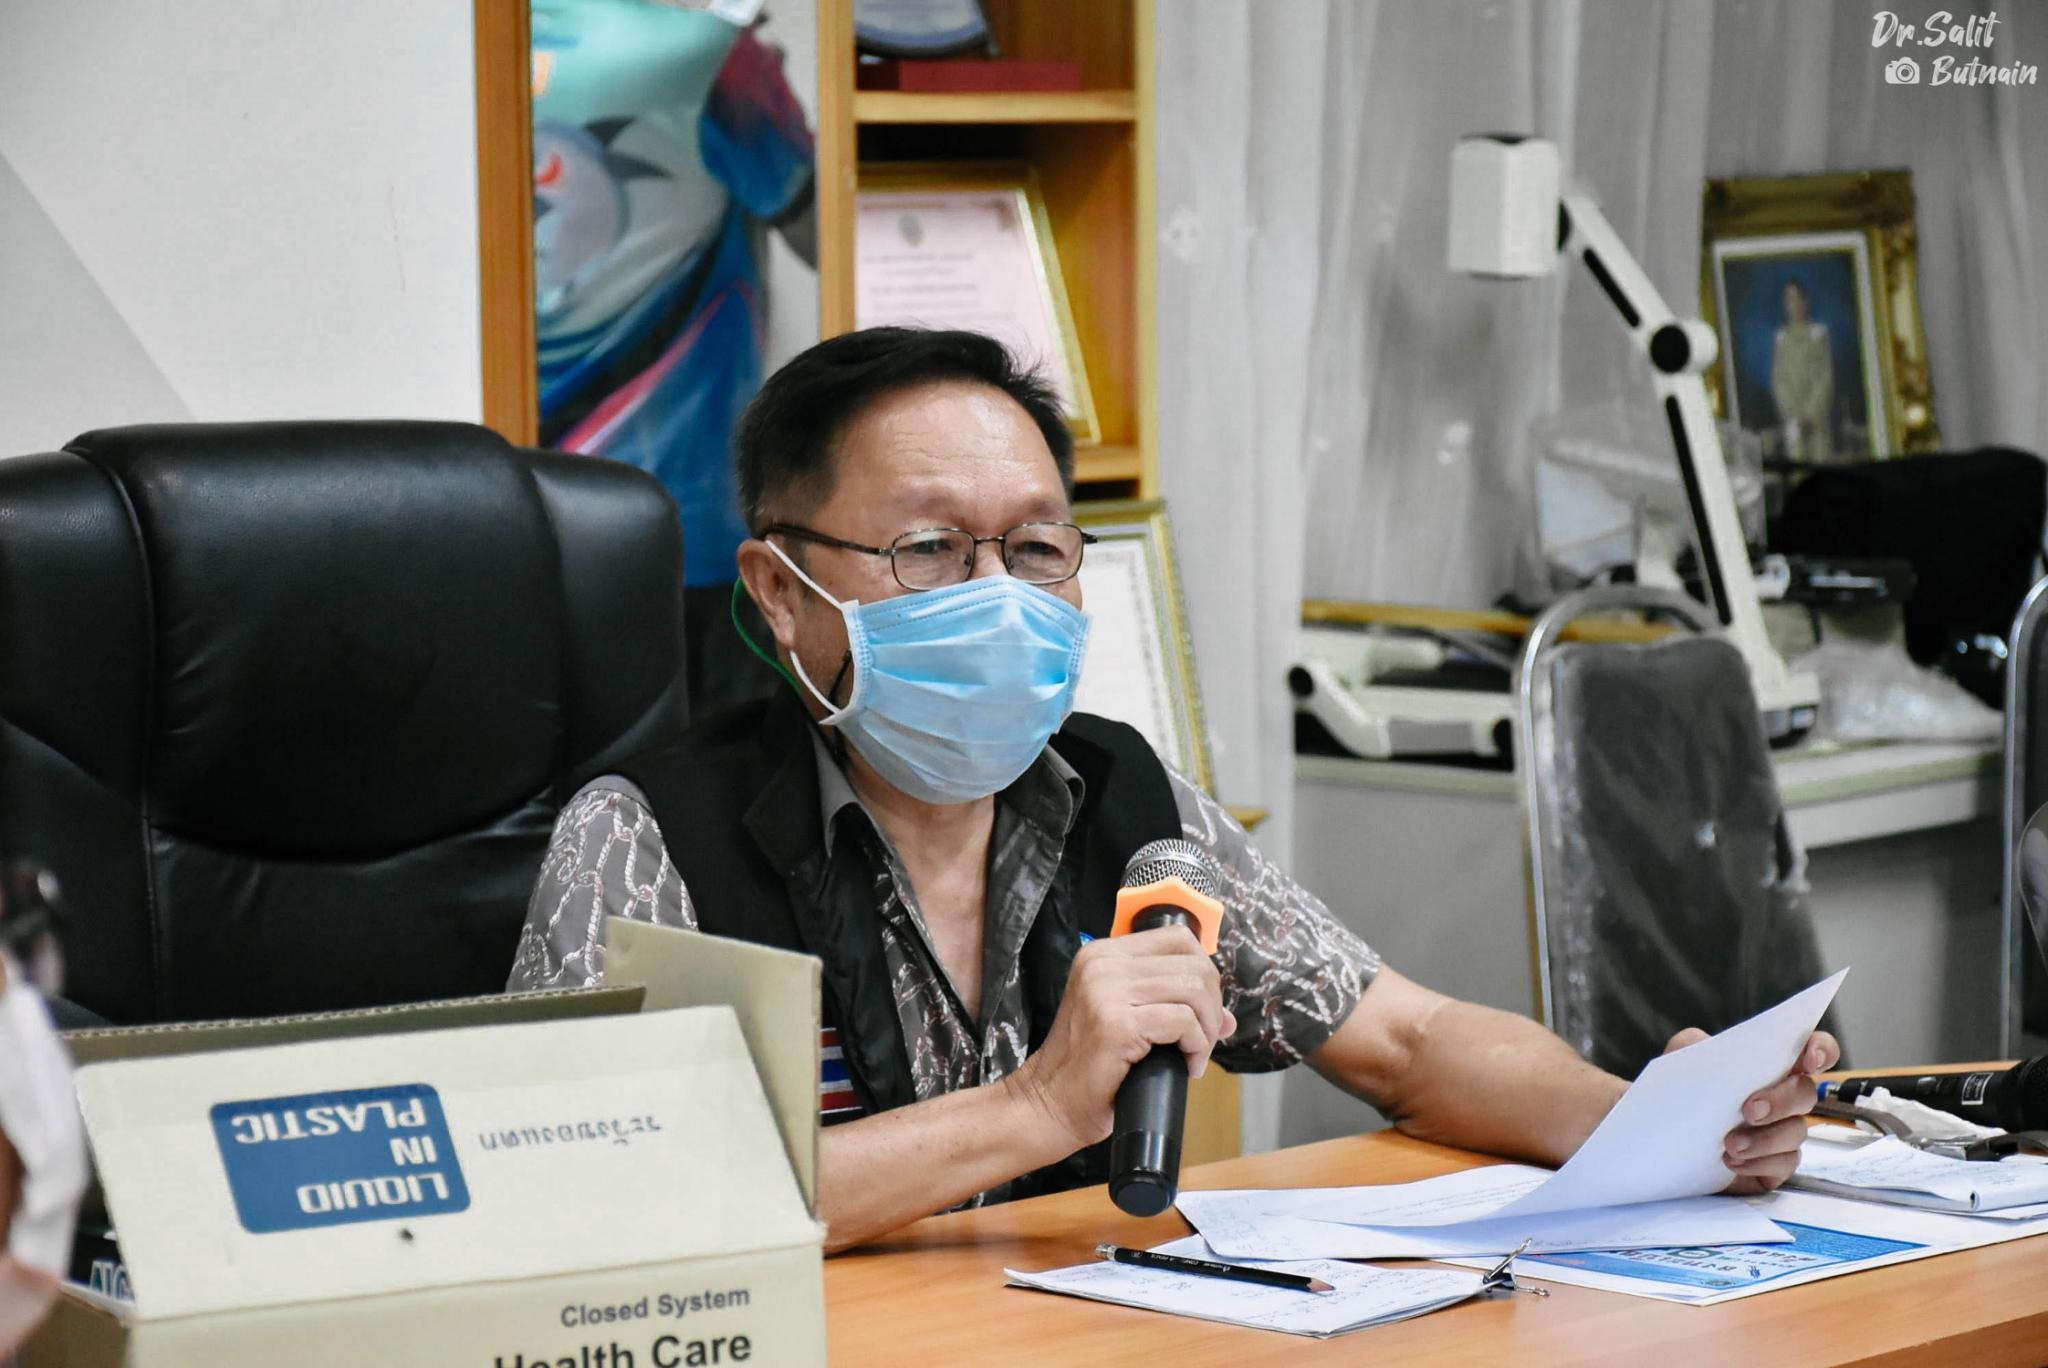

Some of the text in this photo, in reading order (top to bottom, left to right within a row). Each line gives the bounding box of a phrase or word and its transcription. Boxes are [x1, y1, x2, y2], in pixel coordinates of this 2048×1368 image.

[231, 1097, 428, 1144] PLASTIC
[390, 1136, 438, 1165] IN
[296, 1172, 449, 1214] LIQUID
[560, 1289, 751, 1328] Closed System
[493, 1334, 752, 1368] lth Care
